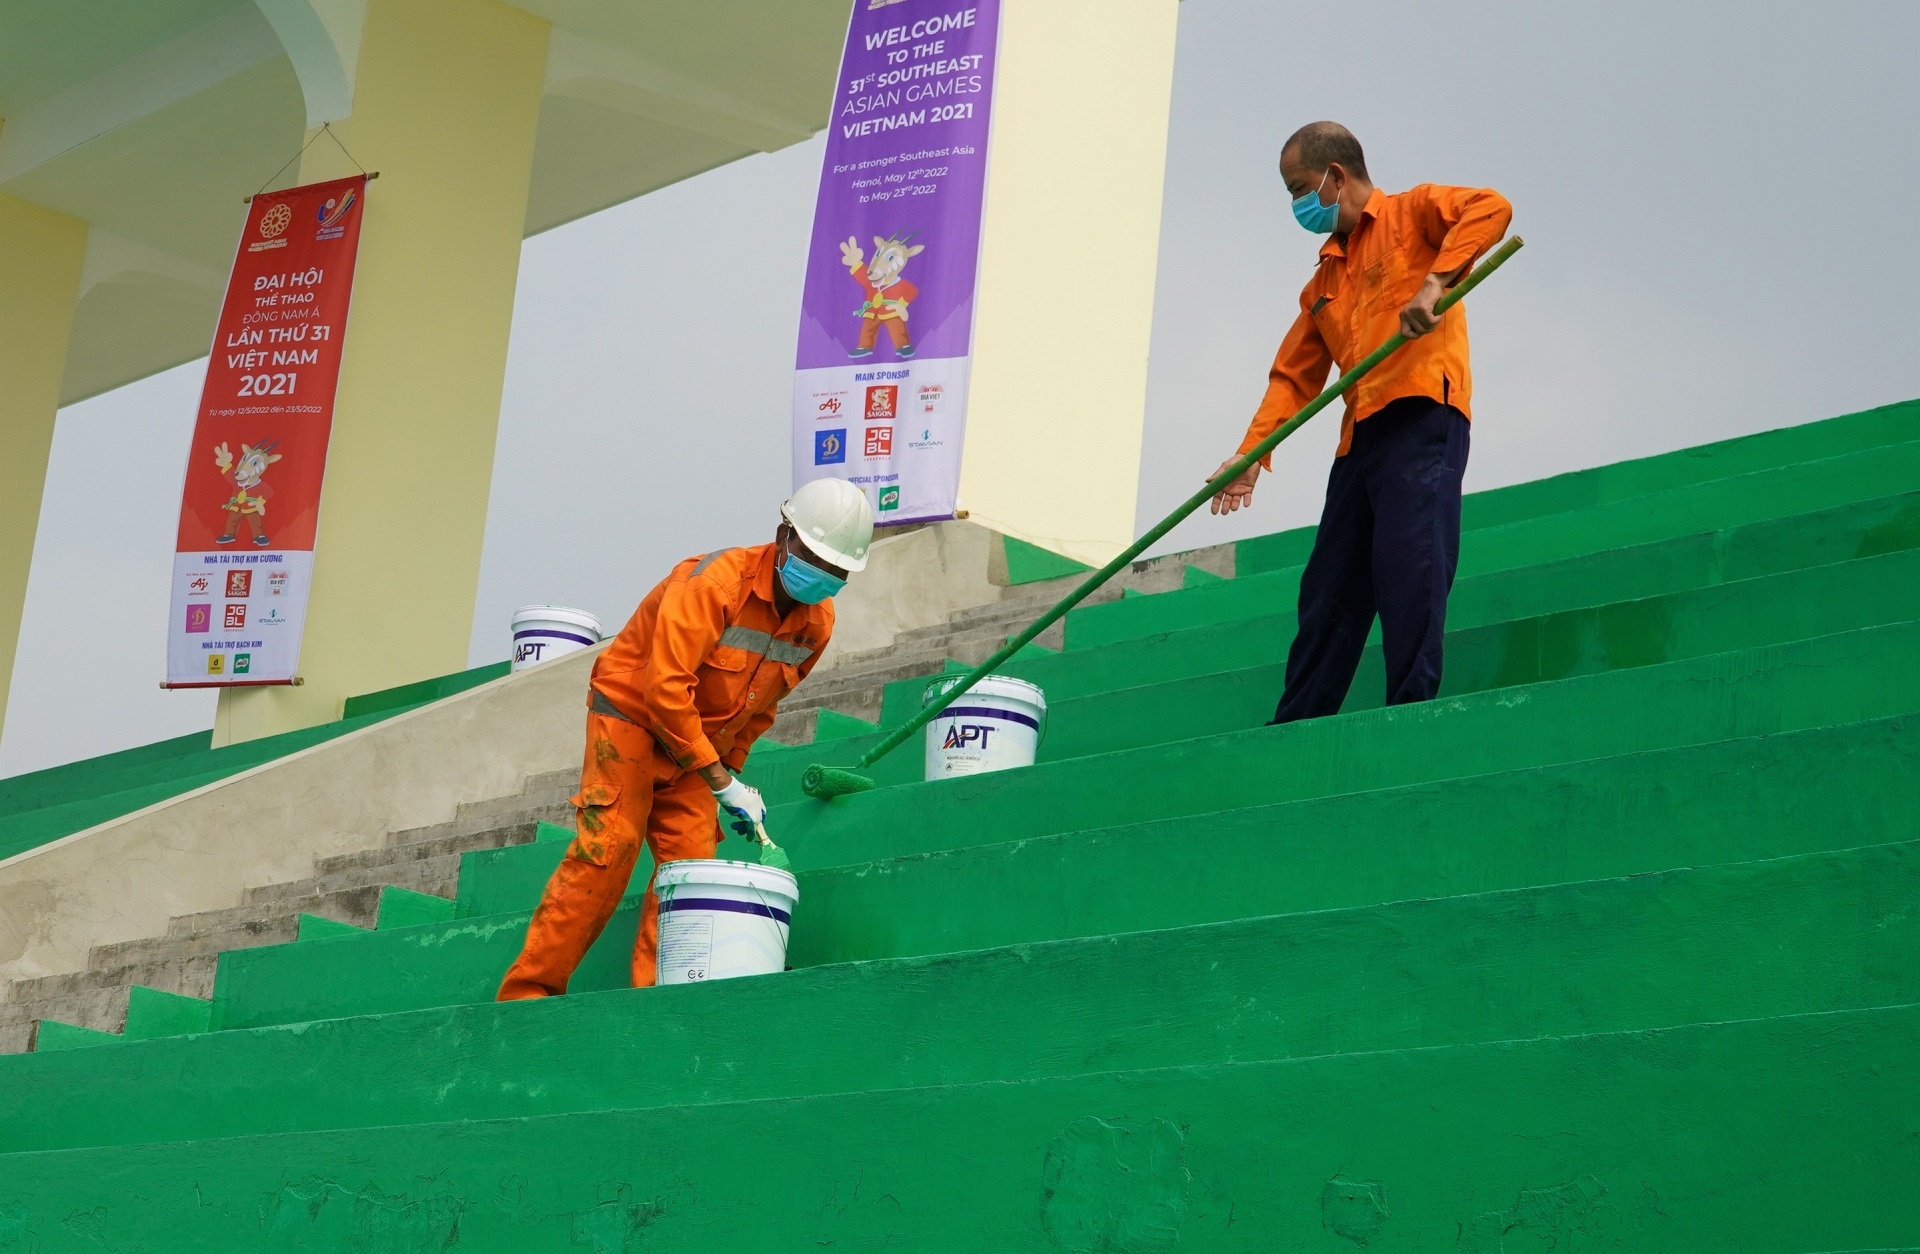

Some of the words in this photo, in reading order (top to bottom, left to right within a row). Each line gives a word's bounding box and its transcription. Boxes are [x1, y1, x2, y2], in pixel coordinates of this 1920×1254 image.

[865, 8, 976, 51] WELCOME
[887, 49, 908, 65] TO
[913, 40, 945, 59] THE
[848, 72, 876, 94] 31st
[877, 54, 983, 88] SOUTHEAST
[841, 89, 900, 117] ASIAN
[906, 75, 982, 102] GAMES
[843, 110, 925, 139] VIETNAM
[930, 103, 973, 123] 2021
[833, 163, 848, 174] For
[850, 163, 856, 171] a
[858, 154, 897, 170] stronger
[899, 147, 949, 162] Southeast
[952, 145, 975, 155] Asia
[851, 177, 882, 189] Hanoi,
[884, 172, 905, 185] May
[859, 195, 869, 203] to
[871, 190, 892, 202] May
[254, 274, 286, 292] ĐẠI
[290, 267, 323, 289] HỘI
[255, 292, 279, 307] THỂ
[281, 293, 314, 305] THAO
[243, 310, 278, 324] ĐÔNG
[281, 309, 309, 320] NAM
[311, 306, 320, 318] Á
[227, 326, 262, 347] LẦN
[268, 323, 310, 343] THỨ
[310, 326, 330, 340] 31
[227, 349, 268, 371] VIỆT
[272, 349, 318, 366] NAM
[237, 373, 297, 397] 2021
[855, 371, 875, 382] MAIN
[876, 369, 910, 380] SPONSOR
[237, 406, 269, 415] 12/5/2022
[270, 405, 284, 413] đến
[285, 405, 322, 414] 23/5/2022
[873, 474, 899, 482] SPONSOR
[204, 554, 218, 564] NHÀ
[220, 554, 229, 564] TÀI
[246, 555, 259, 563] KIM
[236, 641, 250, 650] BẠCH
[251, 640, 263, 648] KIM
[514, 643, 546, 663] APT
[942, 724, 995, 749] APT
